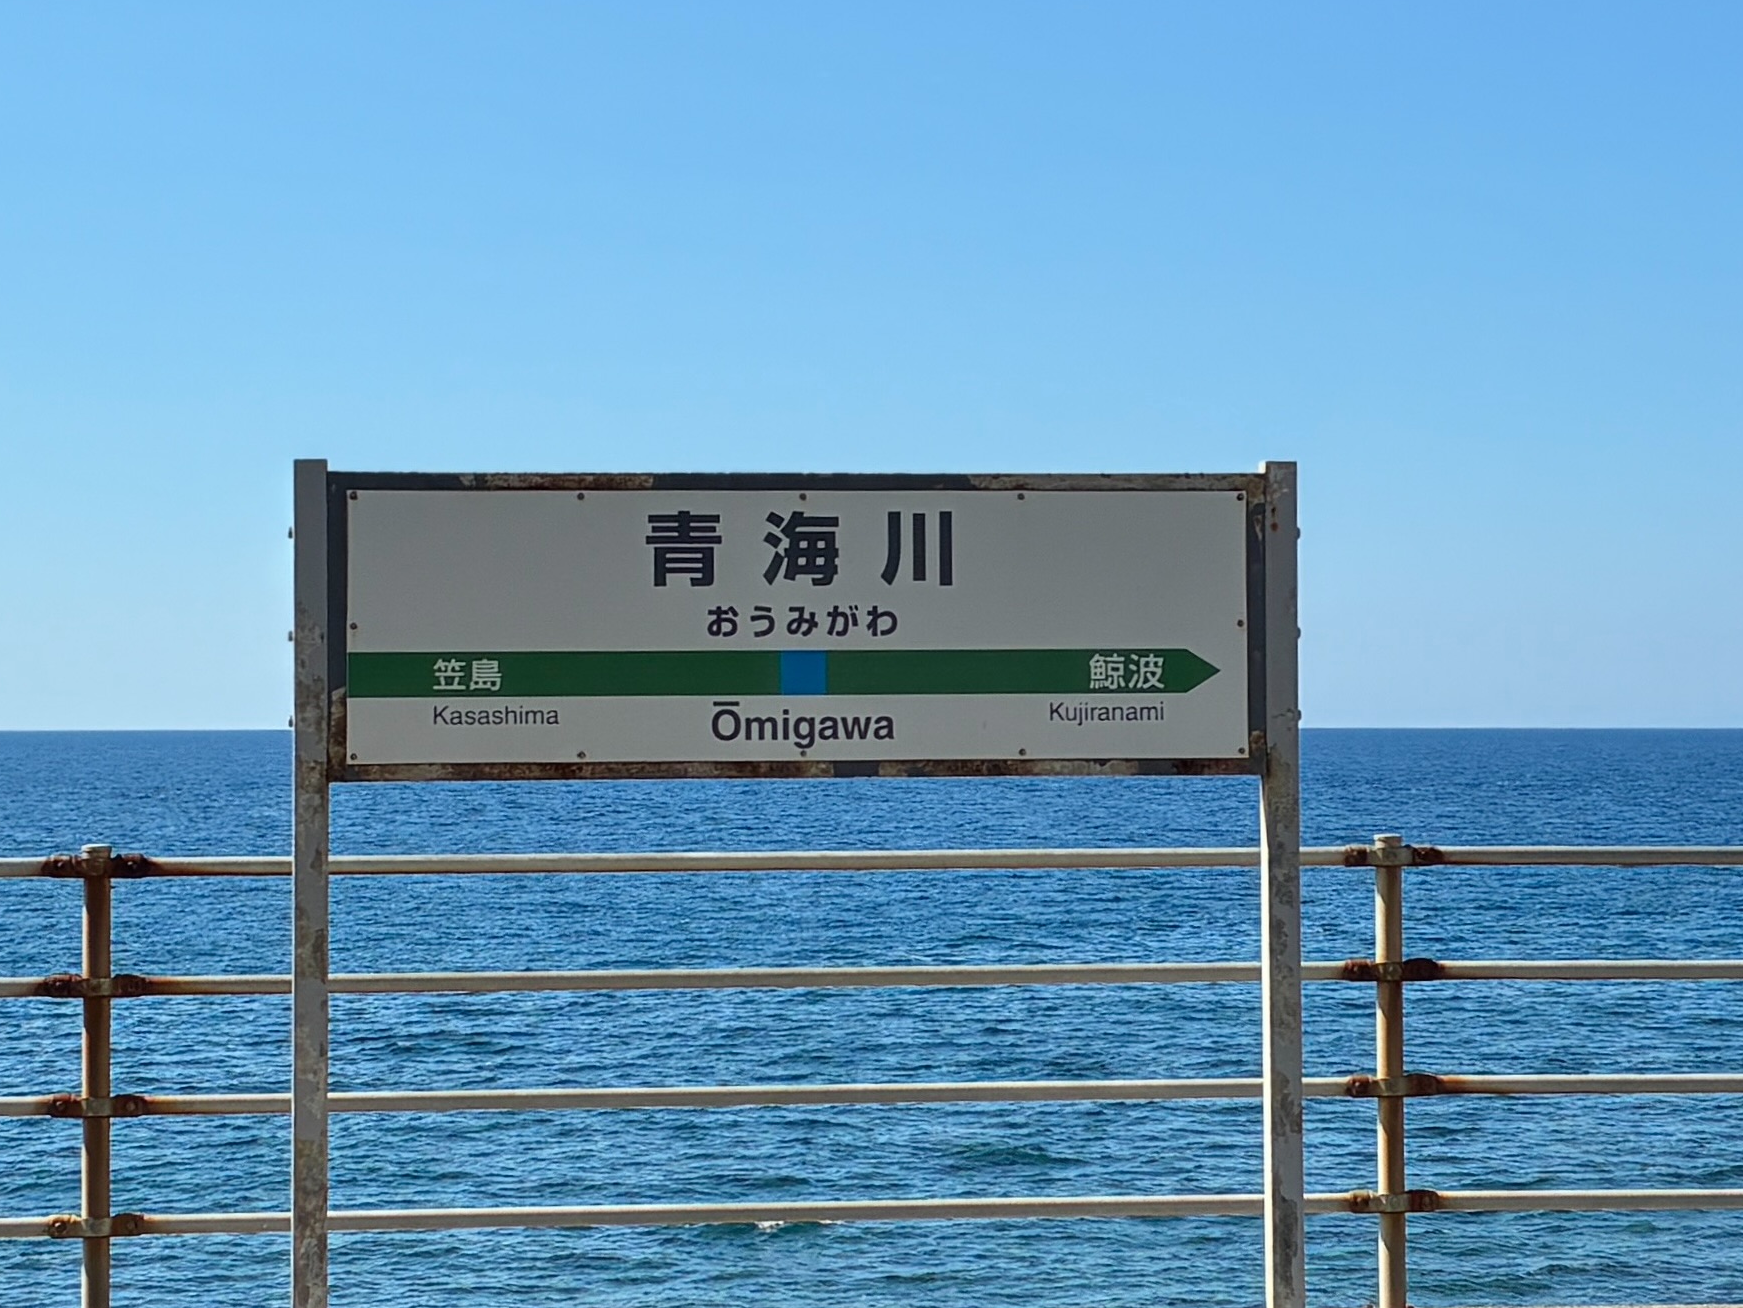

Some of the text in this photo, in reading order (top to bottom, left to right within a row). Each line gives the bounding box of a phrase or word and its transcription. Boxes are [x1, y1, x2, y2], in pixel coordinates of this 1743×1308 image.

[646, 511, 952, 587] 青海川
[707, 605, 899, 637] おうみがわ
[433, 659, 502, 691] 笠島
[1089, 653, 1165, 689] 鯨波
[433, 705, 560, 726] Kasashima
[712, 701, 895, 749] Ōmigawa
[1049, 701, 1165, 726] Kujiranami
